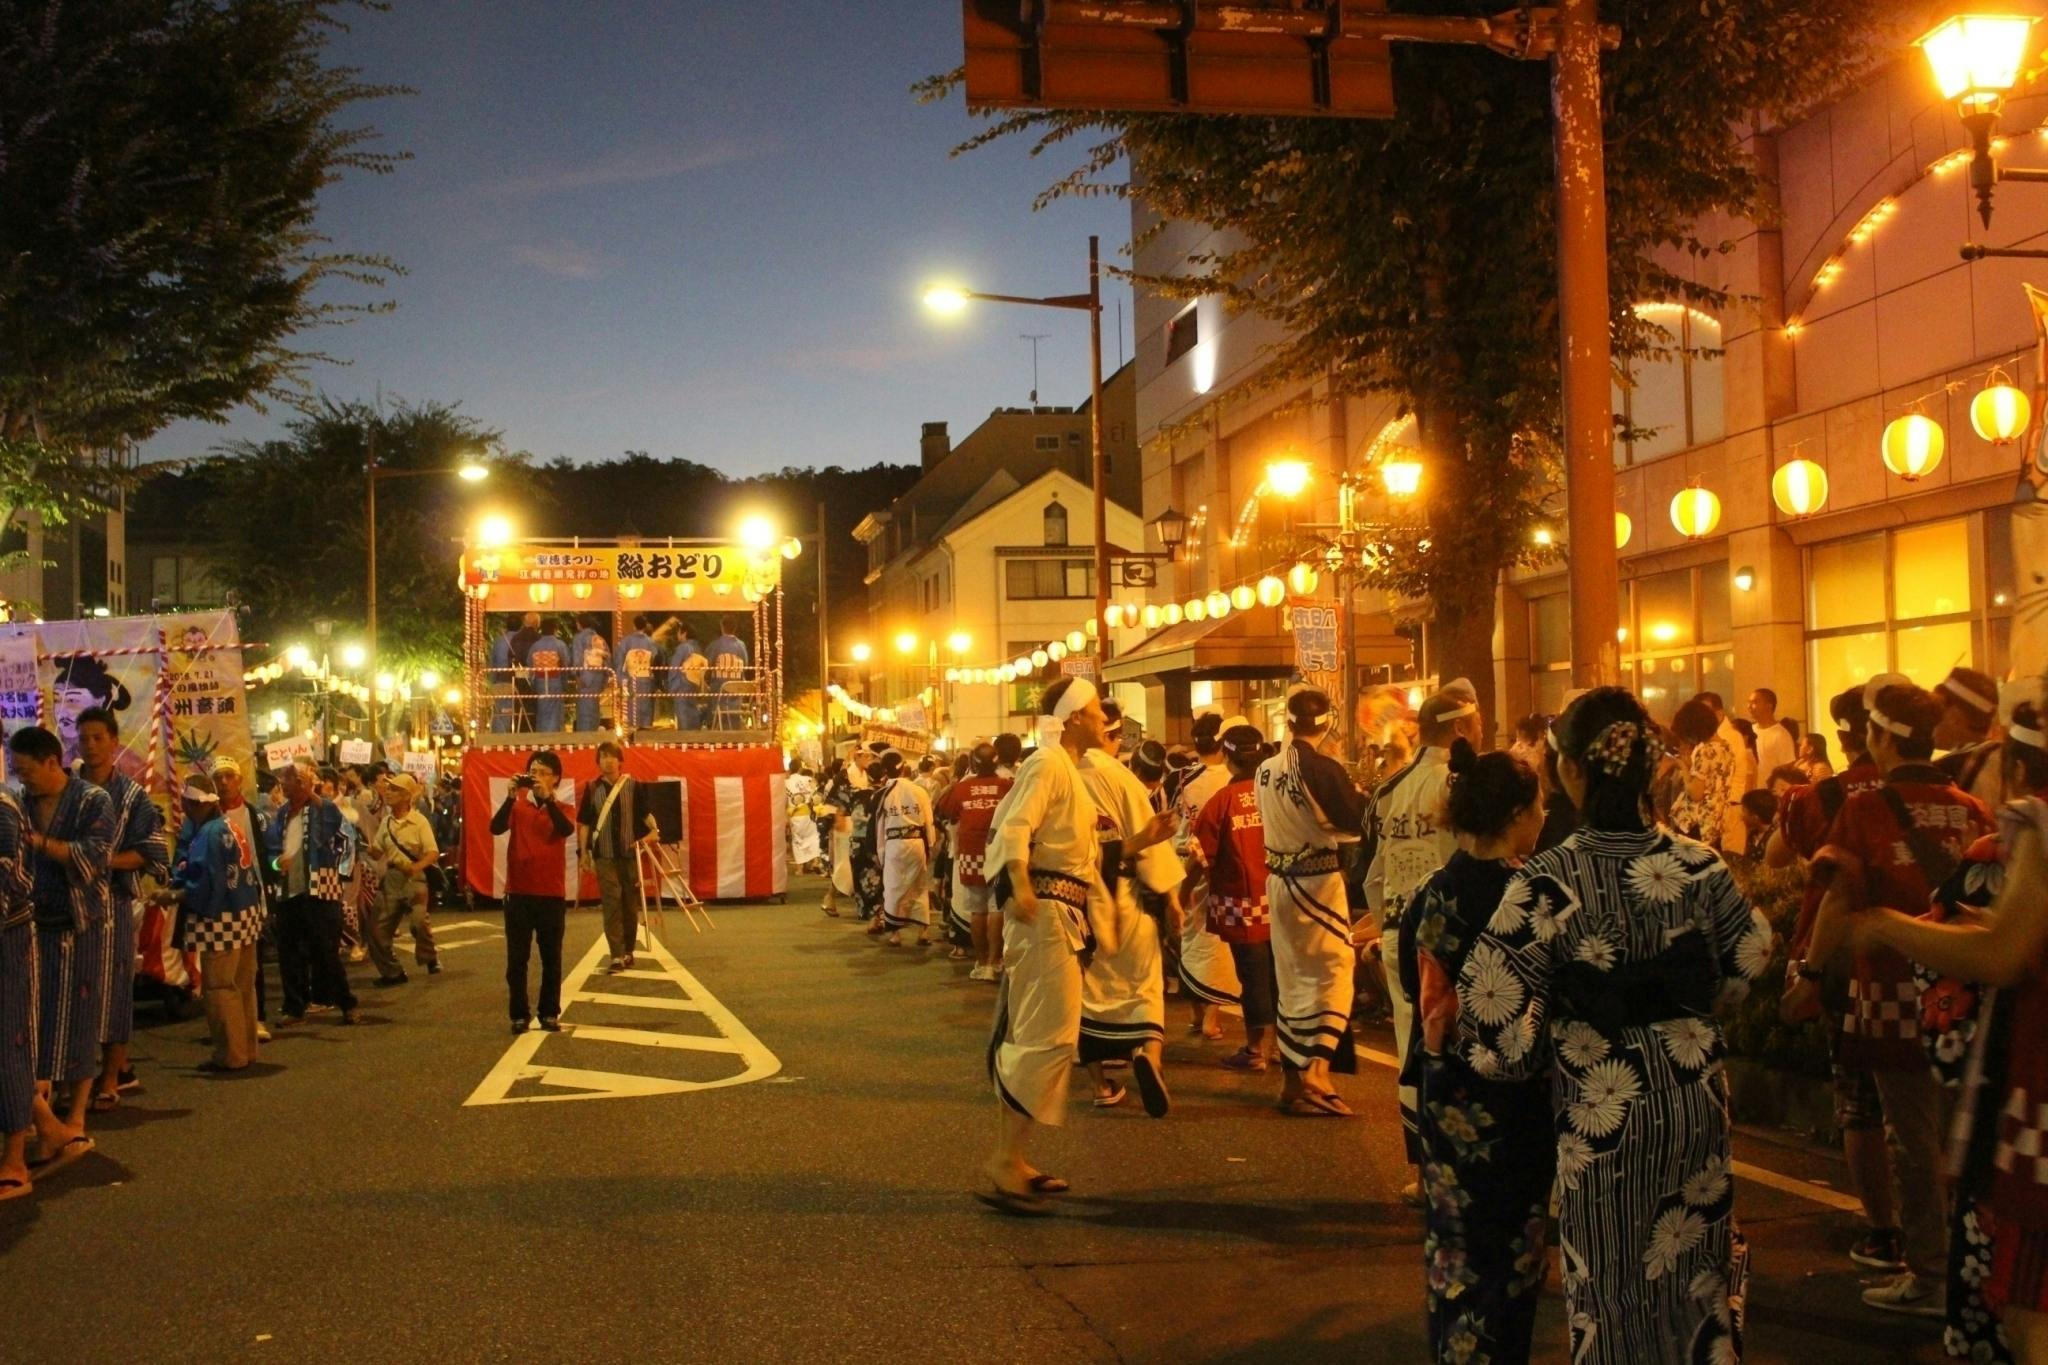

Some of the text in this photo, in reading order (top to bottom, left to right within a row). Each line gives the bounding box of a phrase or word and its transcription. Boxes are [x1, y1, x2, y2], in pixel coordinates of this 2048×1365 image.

[617, 552, 722, 579] 総おどり
[173, 696, 235, 716] 州音頭
